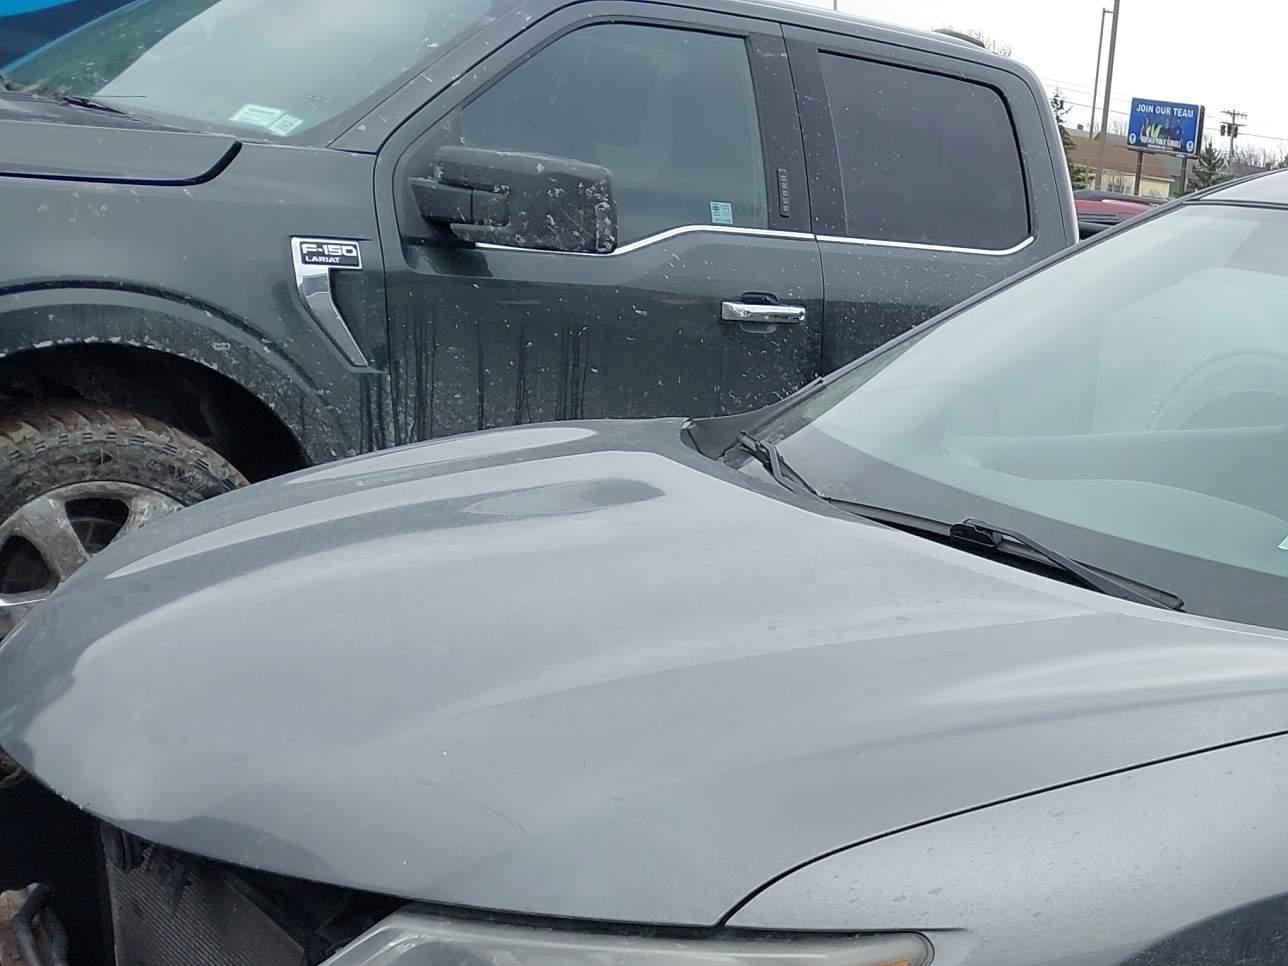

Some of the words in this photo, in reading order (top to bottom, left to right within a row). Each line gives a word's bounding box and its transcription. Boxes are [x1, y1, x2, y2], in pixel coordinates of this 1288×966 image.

[1136, 104, 1154, 113] JOIN
[1155, 105, 1171, 115] OUR
[1173, 107, 1194, 118] TEAM
[301, 243, 357, 257] F-150
[305, 255, 340, 263] LARIAT
